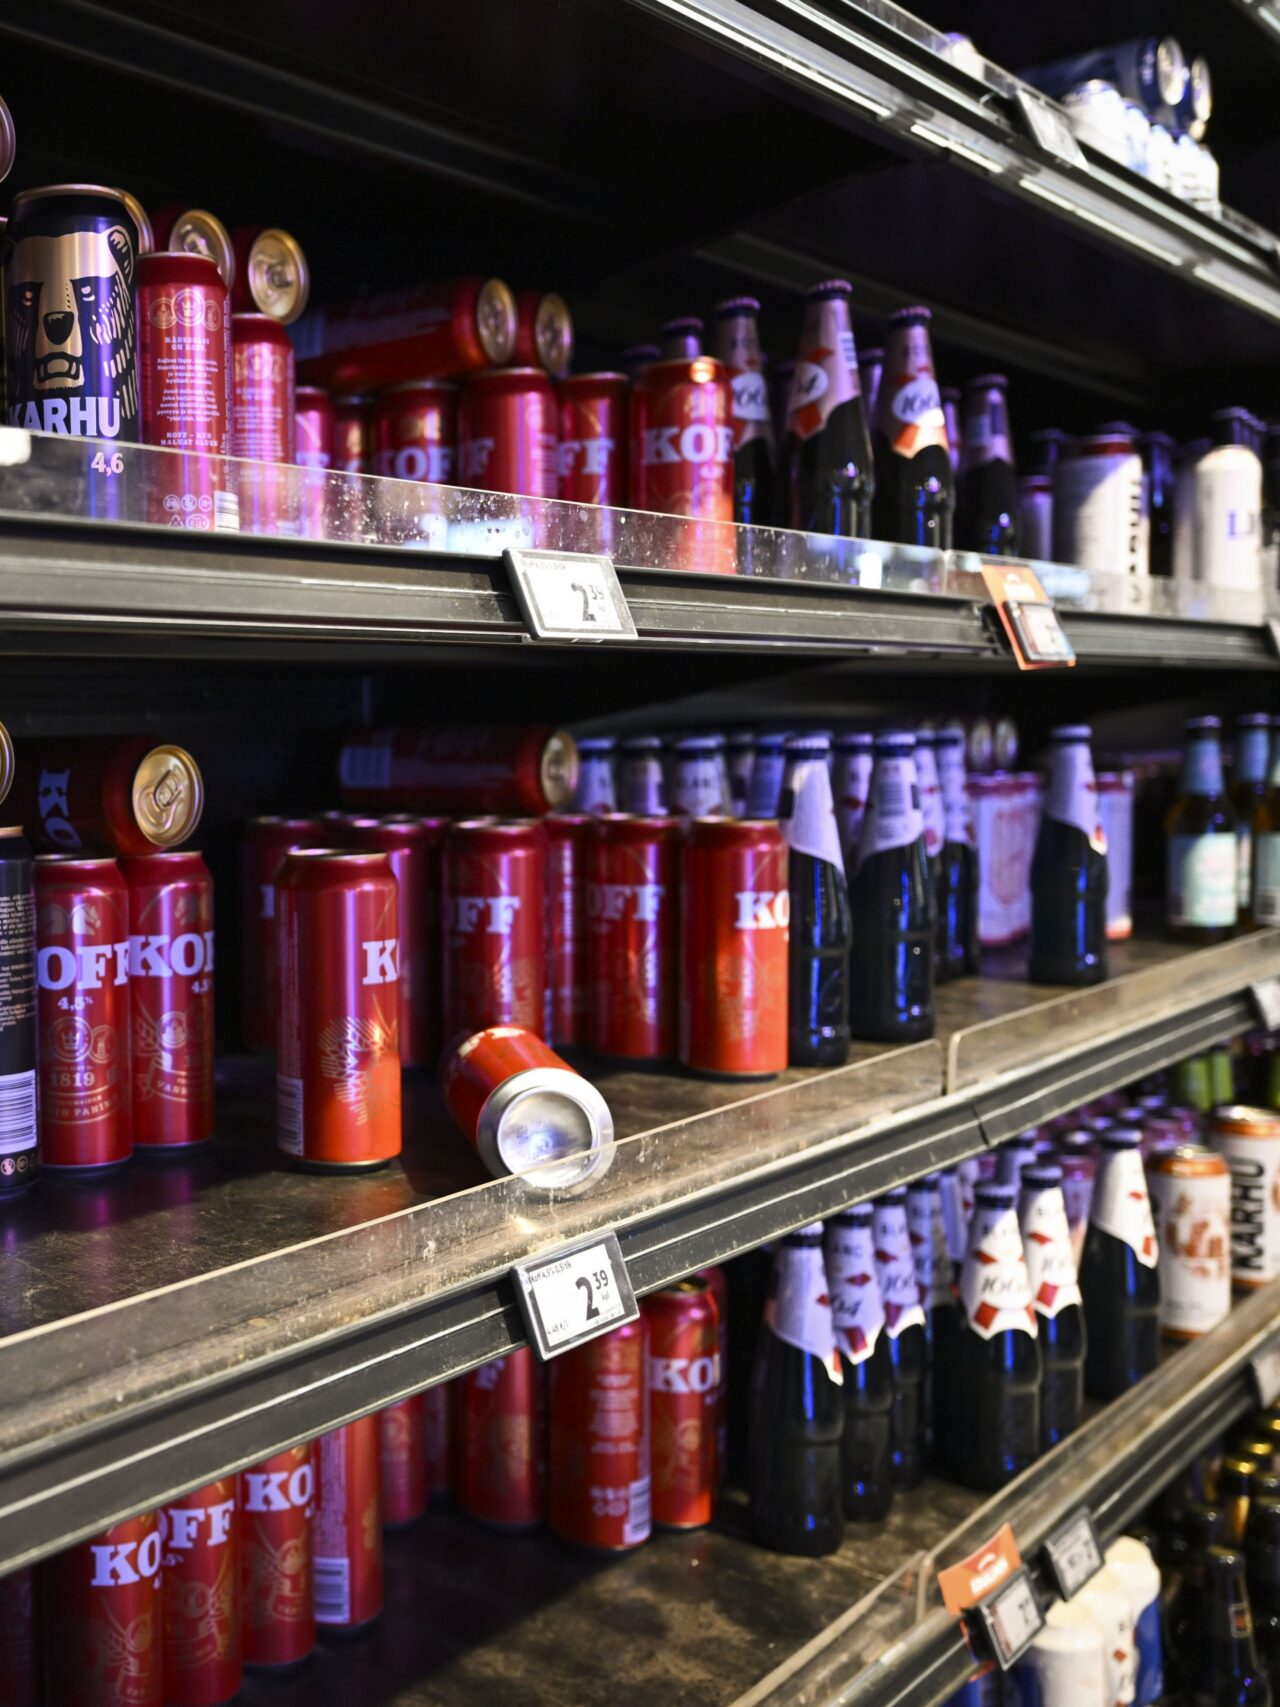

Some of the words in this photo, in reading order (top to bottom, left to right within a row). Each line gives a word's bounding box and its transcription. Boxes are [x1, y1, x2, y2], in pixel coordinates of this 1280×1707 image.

[91, 452, 124, 476] 4,6
[570, 582, 597, 622] 2
[362, 937, 398, 985] K
[1232, 1156, 1265, 1271] KARHU
[575, 1276, 601, 1321] 2
[592, 1269, 609, 1290] 39
